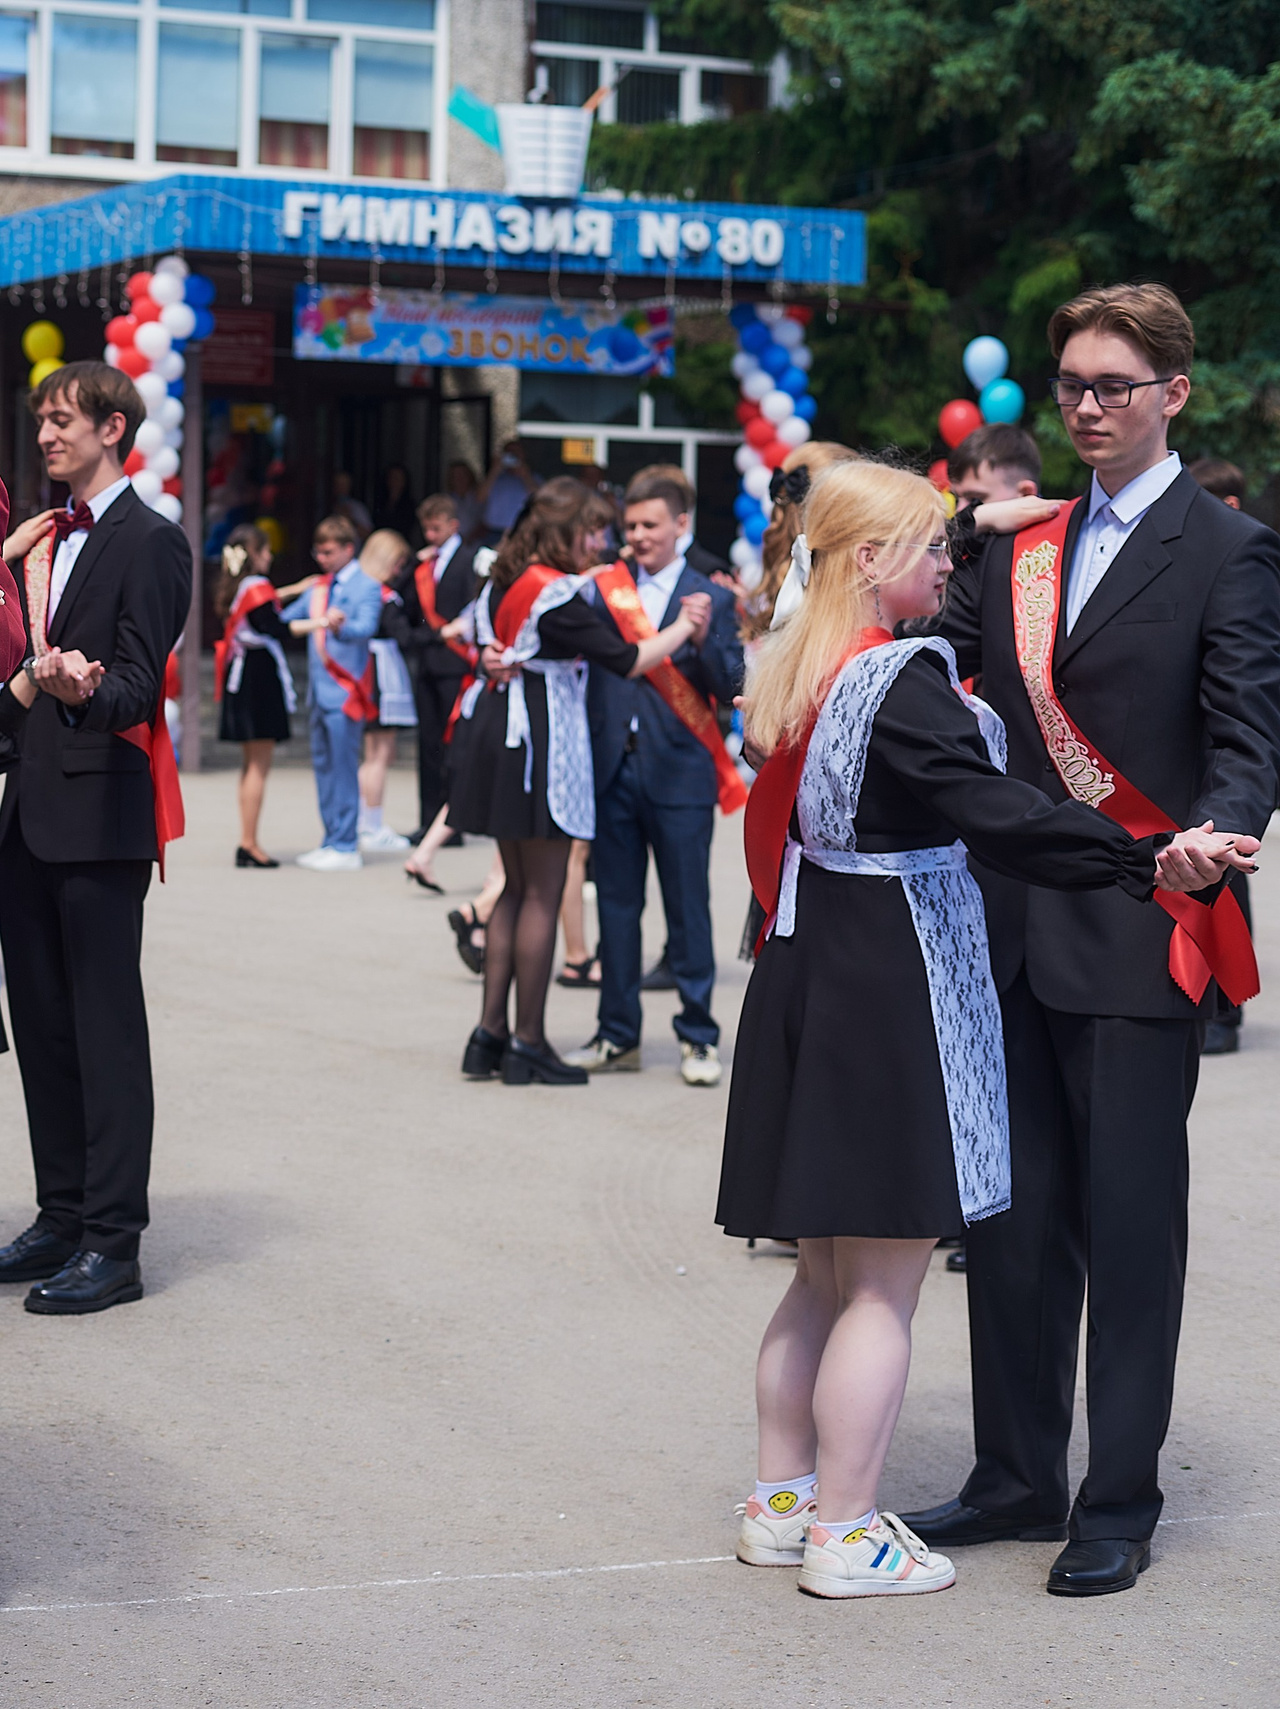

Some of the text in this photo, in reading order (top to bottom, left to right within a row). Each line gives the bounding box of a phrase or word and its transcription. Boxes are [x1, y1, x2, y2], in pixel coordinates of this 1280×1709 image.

[283, 190, 613, 258] ГИМНАЗИЯ
[447, 328, 593, 364] ЗВОНОК
[1054, 740, 1116, 808] 2024
